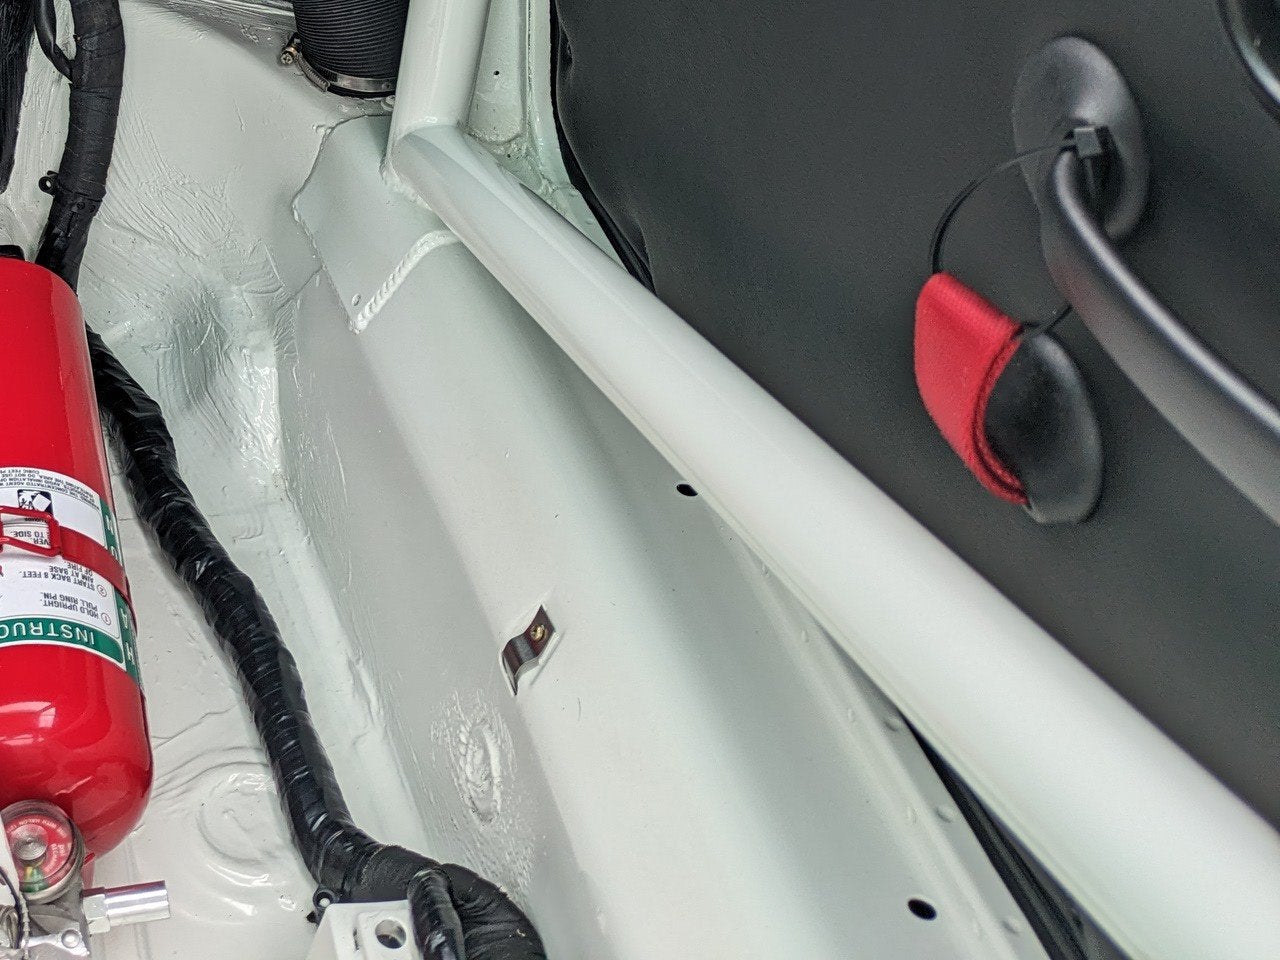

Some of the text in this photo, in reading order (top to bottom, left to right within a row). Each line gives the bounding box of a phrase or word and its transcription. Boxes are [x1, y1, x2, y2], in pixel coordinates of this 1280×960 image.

[19, 570, 42, 578] FEET.
[49, 565, 69, 575] BASE
[64, 561, 93, 576] OF FIRE.
[51, 574, 72, 583] BACK
[82, 573, 94, 583] AIM
[73, 579, 95, 591] START
[40, 592, 98, 611] PULL RING PIN.
[40, 599, 99, 619] HOLD UPRIGHT.
